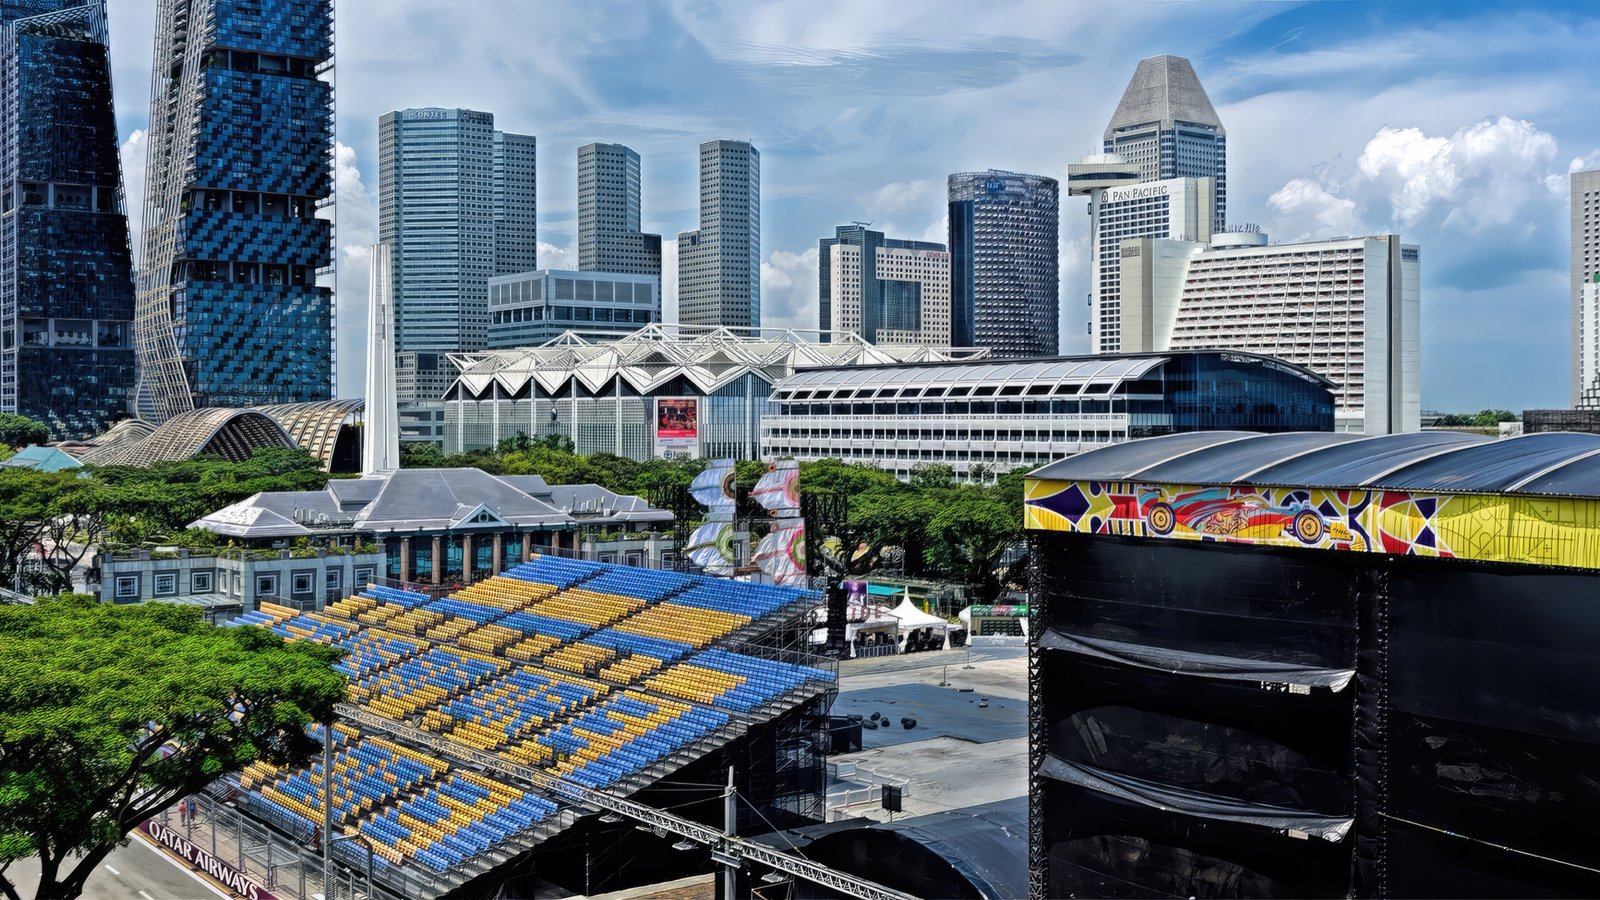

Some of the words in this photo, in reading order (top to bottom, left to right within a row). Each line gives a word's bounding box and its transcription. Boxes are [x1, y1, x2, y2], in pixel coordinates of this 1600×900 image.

[986, 181, 1001, 189] LGT
[1112, 190, 1131, 202] PAN
[1132, 185, 1168, 199] PACIFIC
[149, 821, 193, 861] QATAR
[195, 851, 260, 900] AIRWAYS
